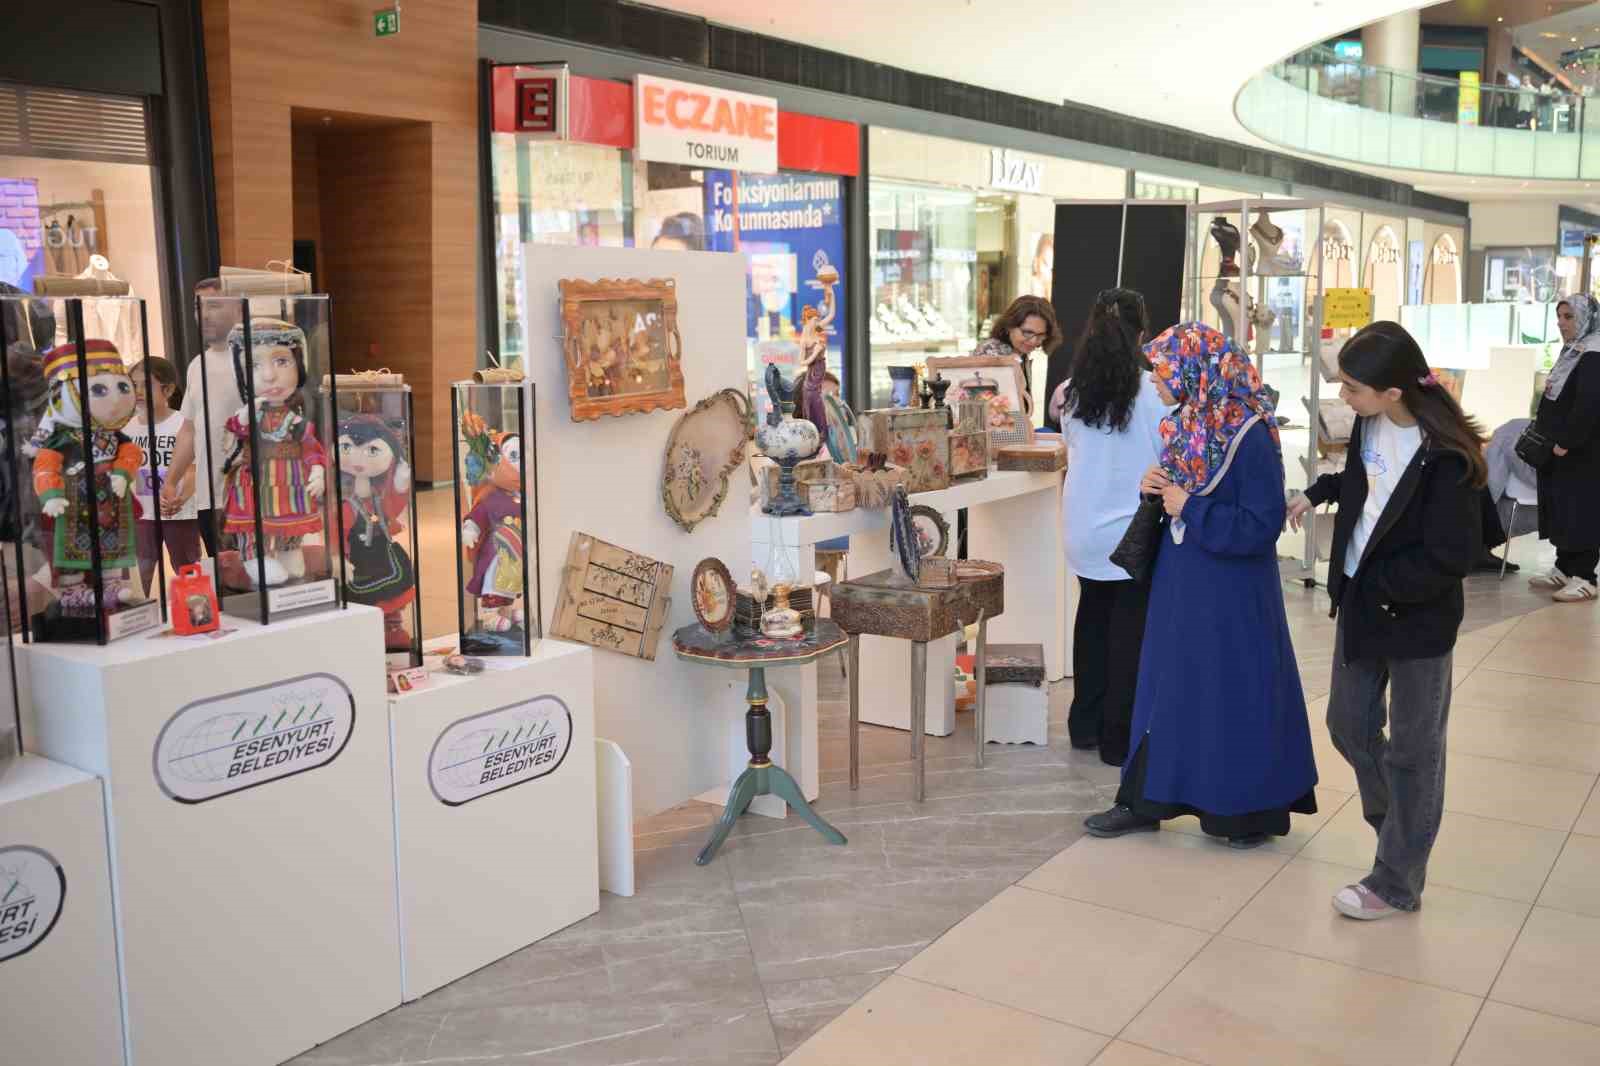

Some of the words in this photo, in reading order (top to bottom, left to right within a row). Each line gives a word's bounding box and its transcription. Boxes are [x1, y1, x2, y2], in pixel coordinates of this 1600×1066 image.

[643, 85, 774, 140] ECZANE
[686, 141, 739, 161] TORIUM
[714, 202, 832, 232] Kounmasında
[233, 720, 334, 760] ESENYURT
[484, 735, 556, 769] ESENYURT
